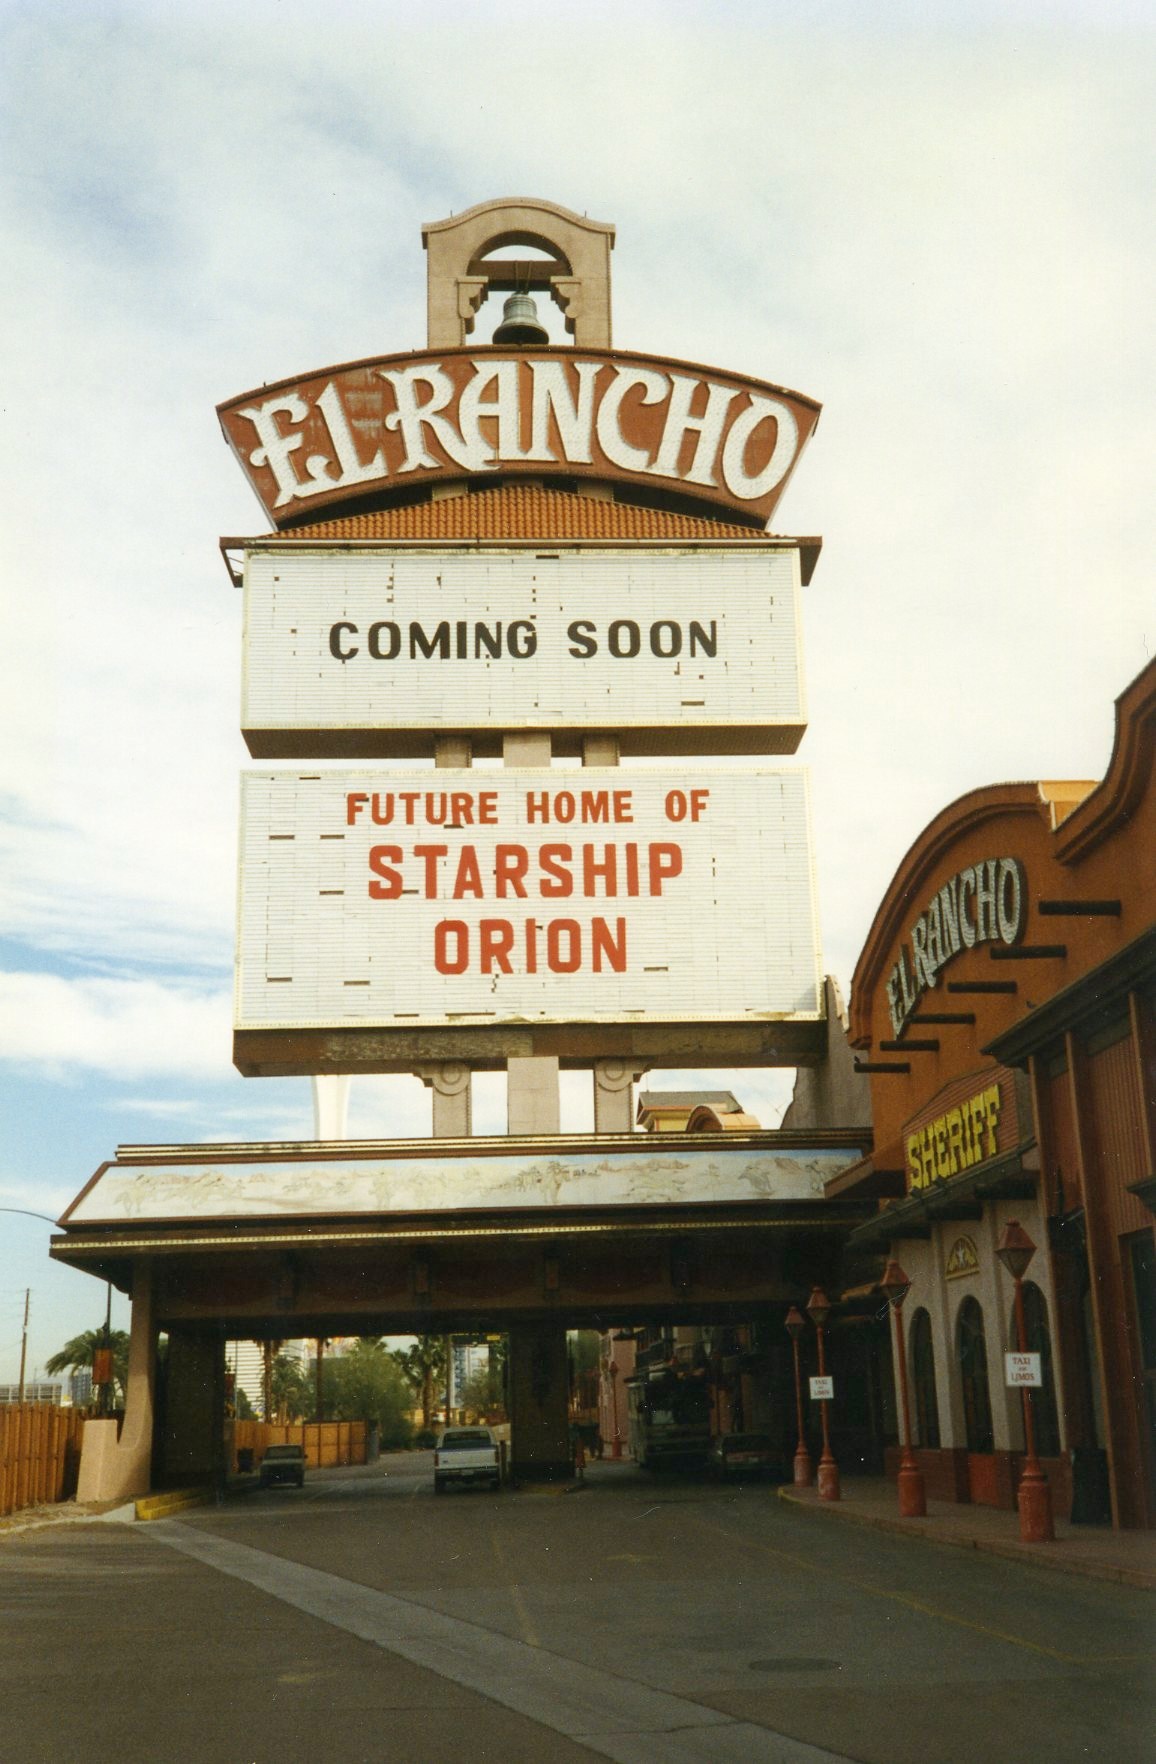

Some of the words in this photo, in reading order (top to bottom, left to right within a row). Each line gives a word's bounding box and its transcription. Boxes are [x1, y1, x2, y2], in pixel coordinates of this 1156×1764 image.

[238, 381, 384, 508] EL
[380, 360, 798, 500] RANCHO
[329, 620, 538, 660] COMING
[567, 619, 717, 659] SOON
[346, 792, 499, 825] FUTURE
[526, 789, 634, 824] HOME
[664, 788, 710, 823] OF
[367, 842, 684, 900] STARSHIP
[434, 917, 628, 975] ORION
[886, 945, 917, 1040] EL
[911, 857, 1021, 988] RANCHO
[906, 1083, 1001, 1190] SHERIFF
[1012, 1357, 1031, 1365] TAXI
